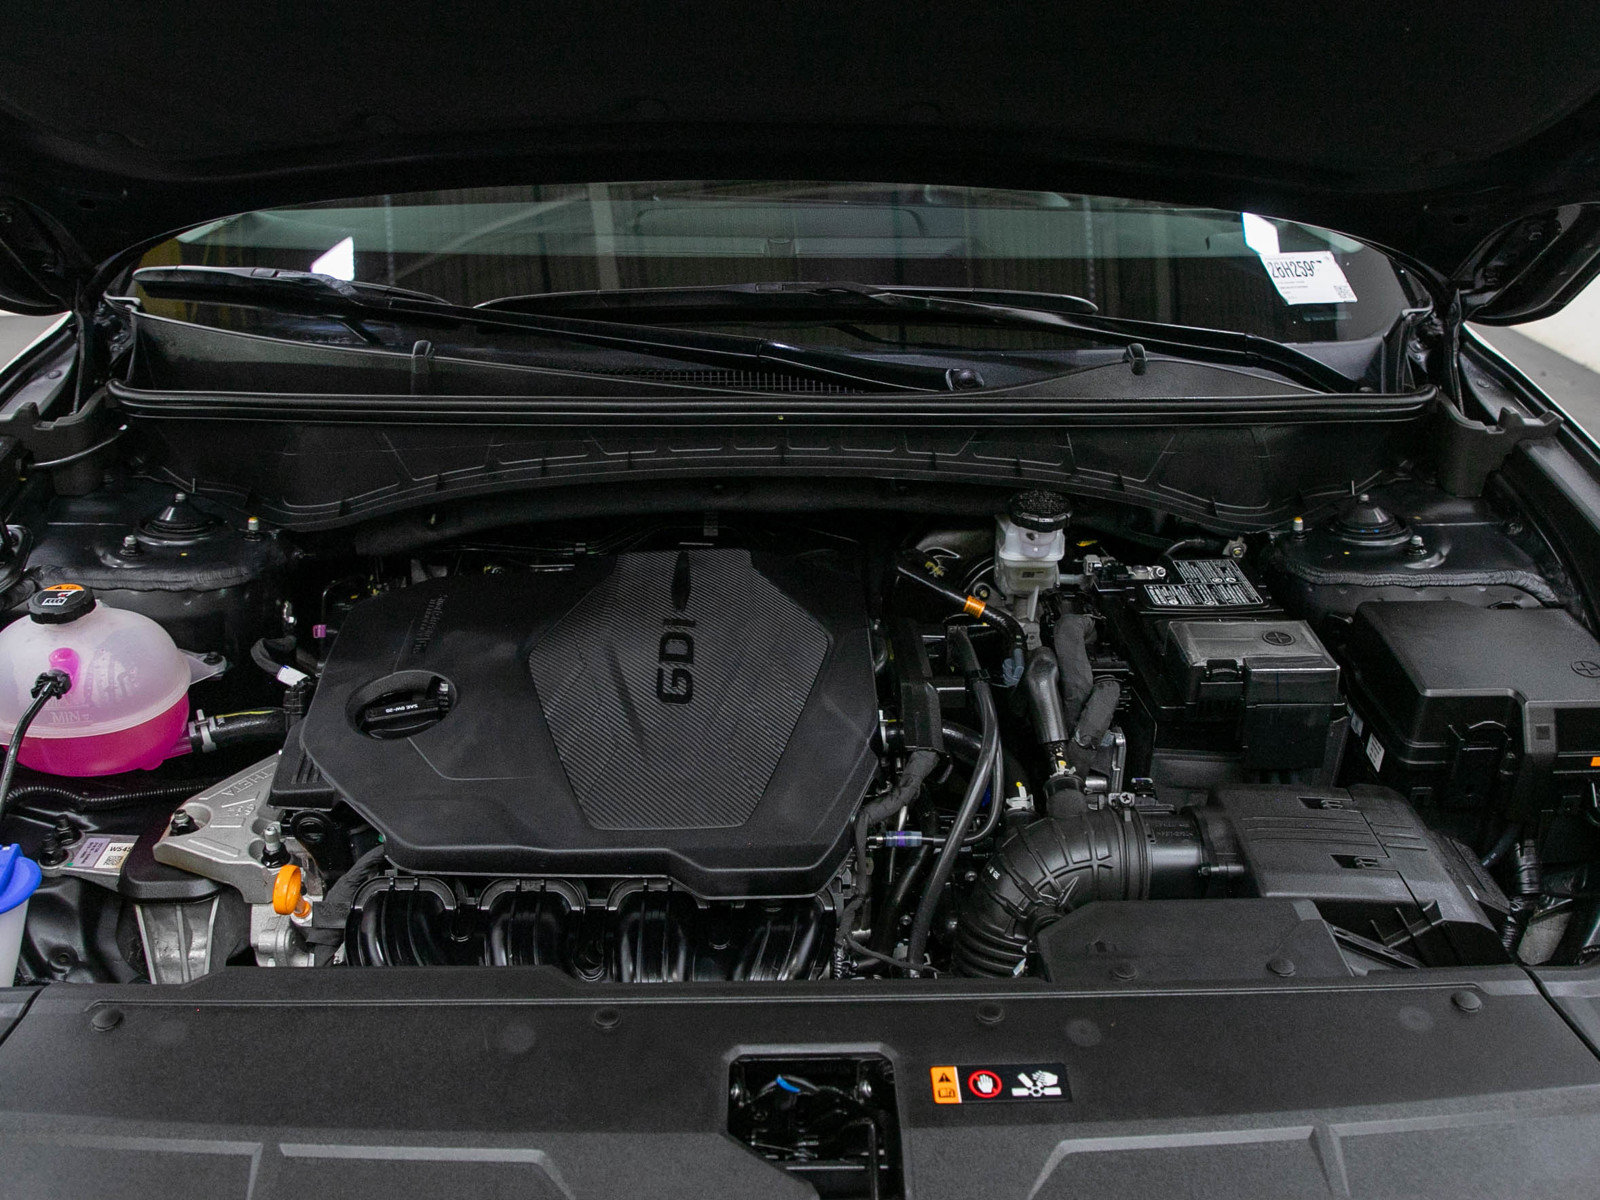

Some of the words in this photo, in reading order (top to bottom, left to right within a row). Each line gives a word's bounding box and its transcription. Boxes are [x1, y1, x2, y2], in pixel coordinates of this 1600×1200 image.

[1267, 259, 1322, 279] 26H259
[656, 619, 696, 705] GDI
[221, 770, 274, 796] THETA
